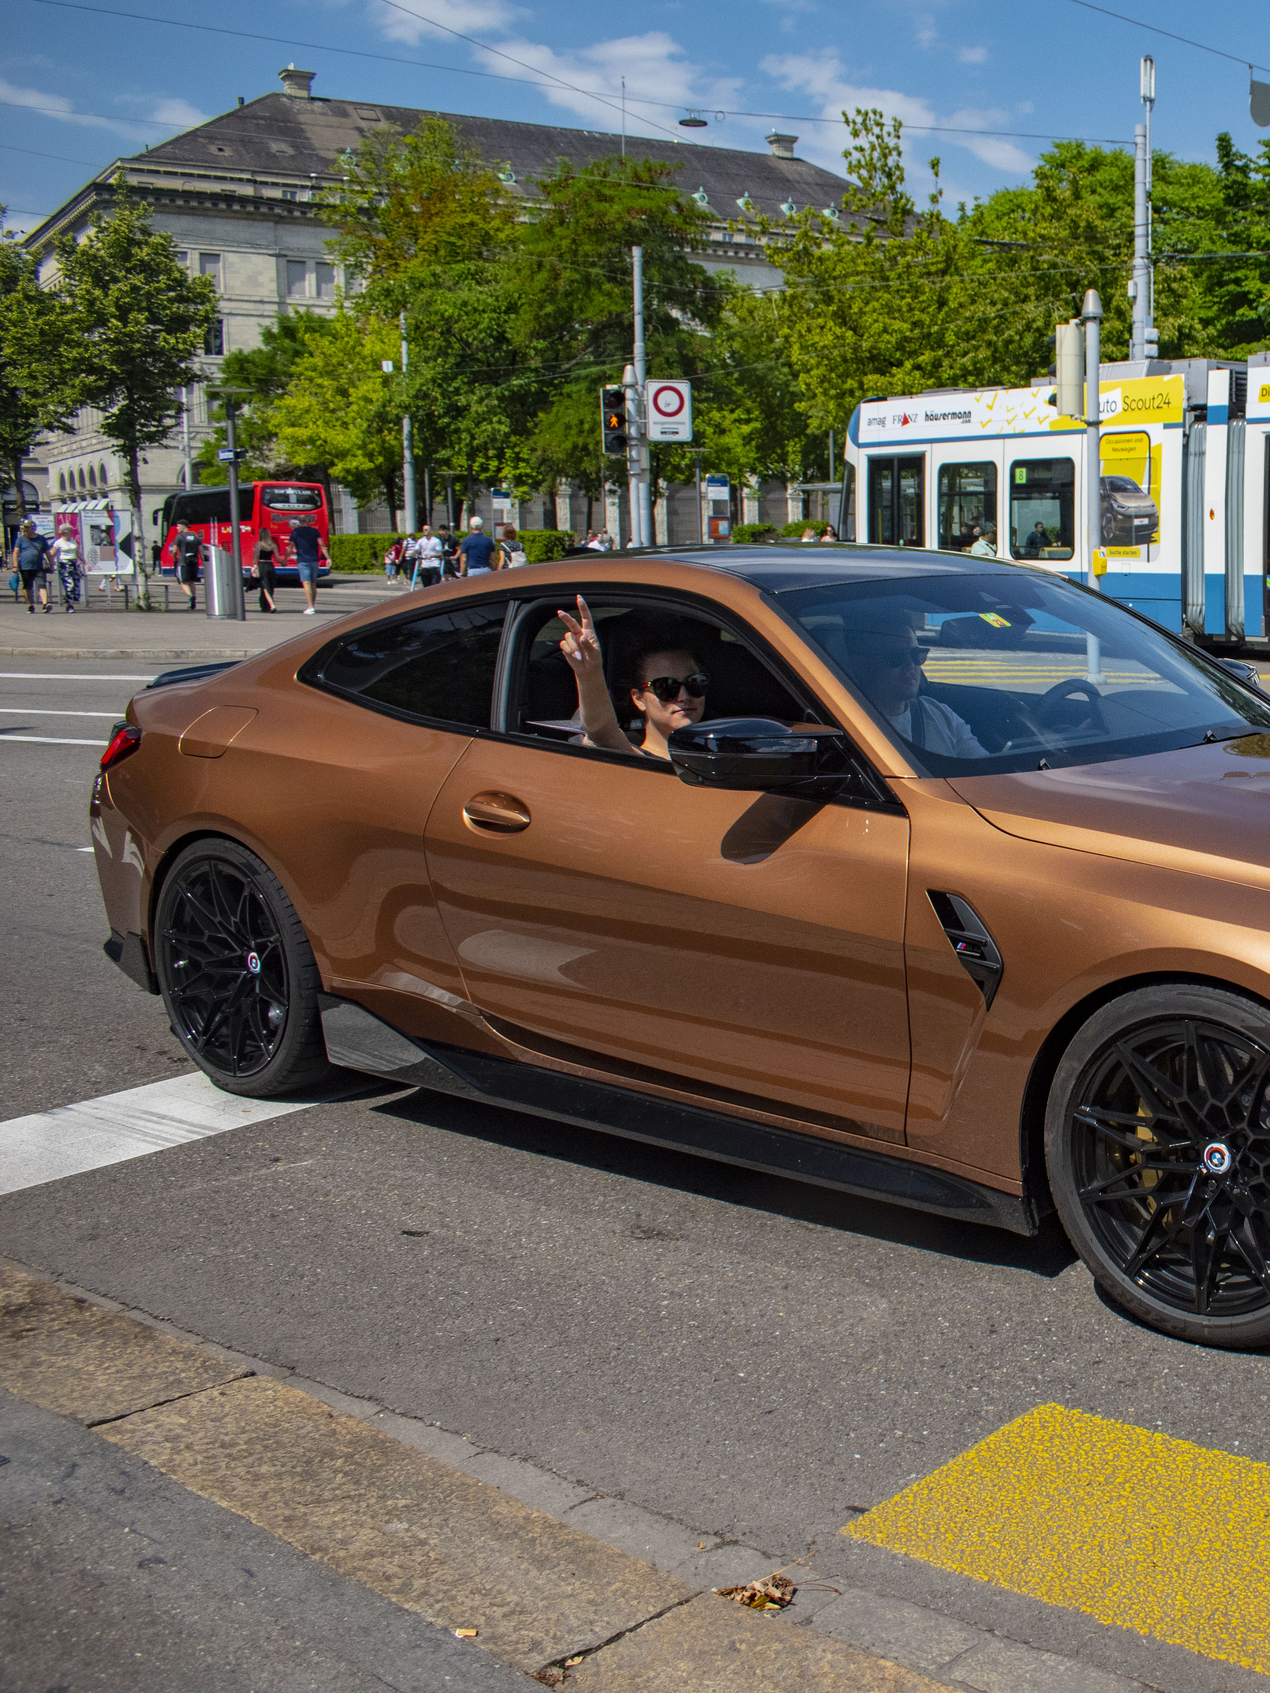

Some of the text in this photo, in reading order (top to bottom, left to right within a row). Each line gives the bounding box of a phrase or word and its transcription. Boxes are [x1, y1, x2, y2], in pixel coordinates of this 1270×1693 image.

[1098, 392, 1171, 414] uto Scout24
[867, 416, 887, 428] amag
[924, 410, 972, 422] häusermann
[1105, 437, 1133, 445] Occasionen
[1018, 470, 1024, 481] 8
